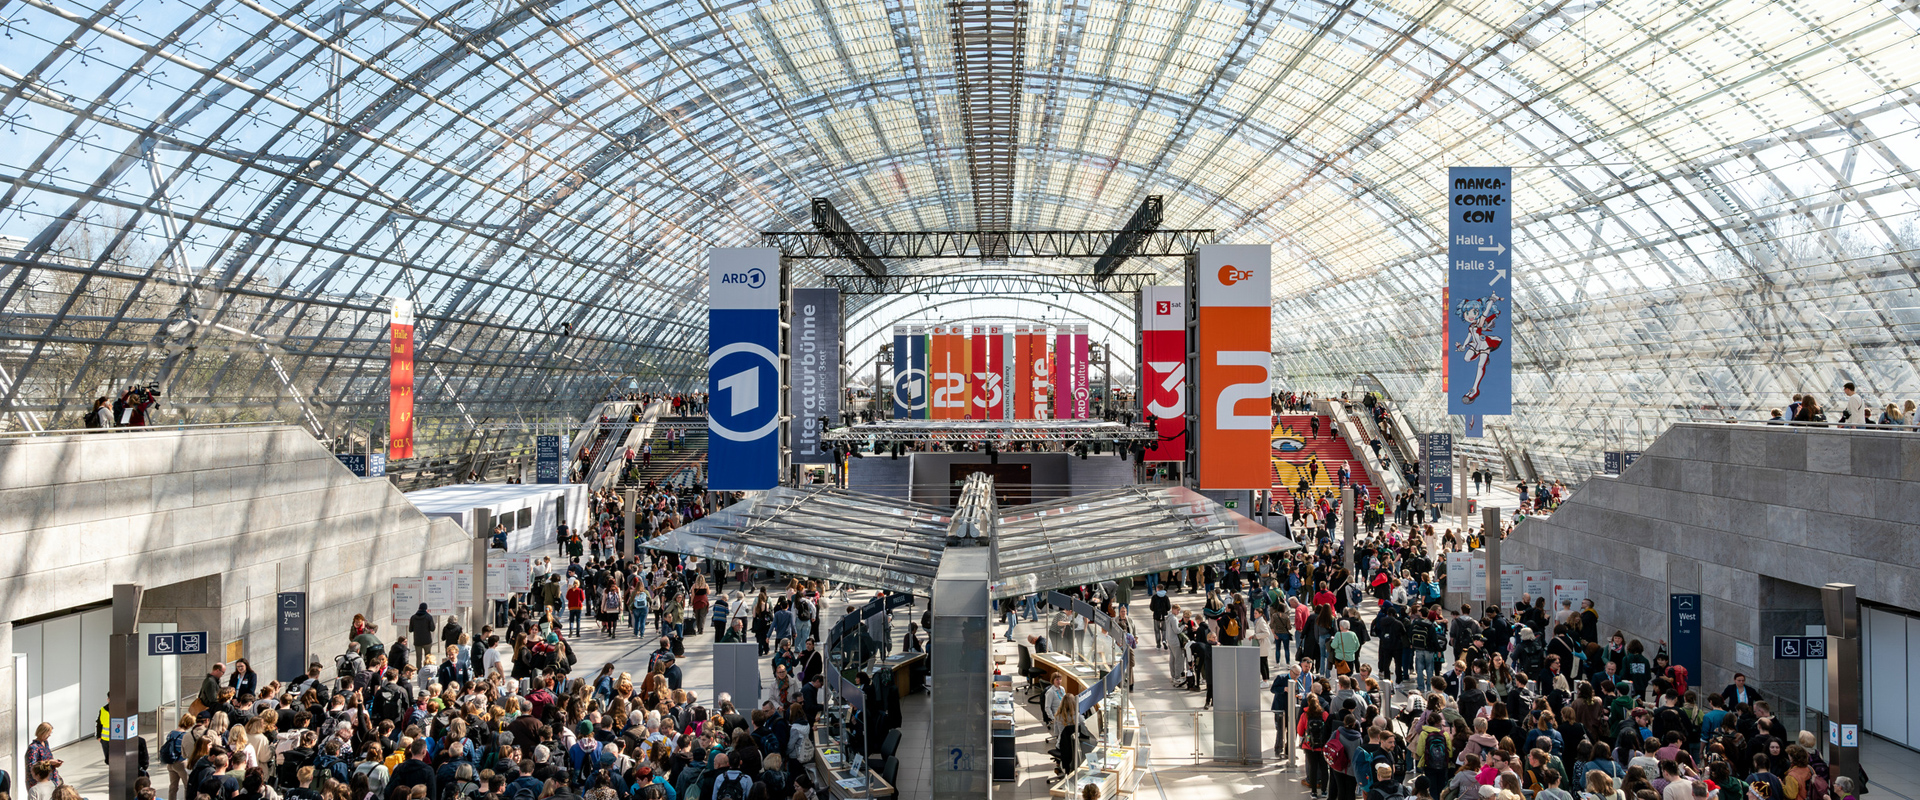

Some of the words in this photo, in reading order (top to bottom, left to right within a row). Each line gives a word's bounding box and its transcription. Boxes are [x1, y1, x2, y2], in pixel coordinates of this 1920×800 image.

[1454, 178, 1506, 190] MANGA-
[1463, 210, 1495, 223] CON
[1456, 234, 1484, 245] Halle
[1488, 235, 1494, 245] 1
[1456, 260, 1484, 270] Halle
[1488, 260, 1494, 270] 3
[394, 329, 408, 340] Halle
[394, 344, 404, 353] hall
[401, 361, 404, 370] 1
[800, 304, 816, 456] Literaturbühne
[401, 387, 404, 396] 2
[1032, 358, 1048, 419] arte
[400, 412, 405, 421] 4
